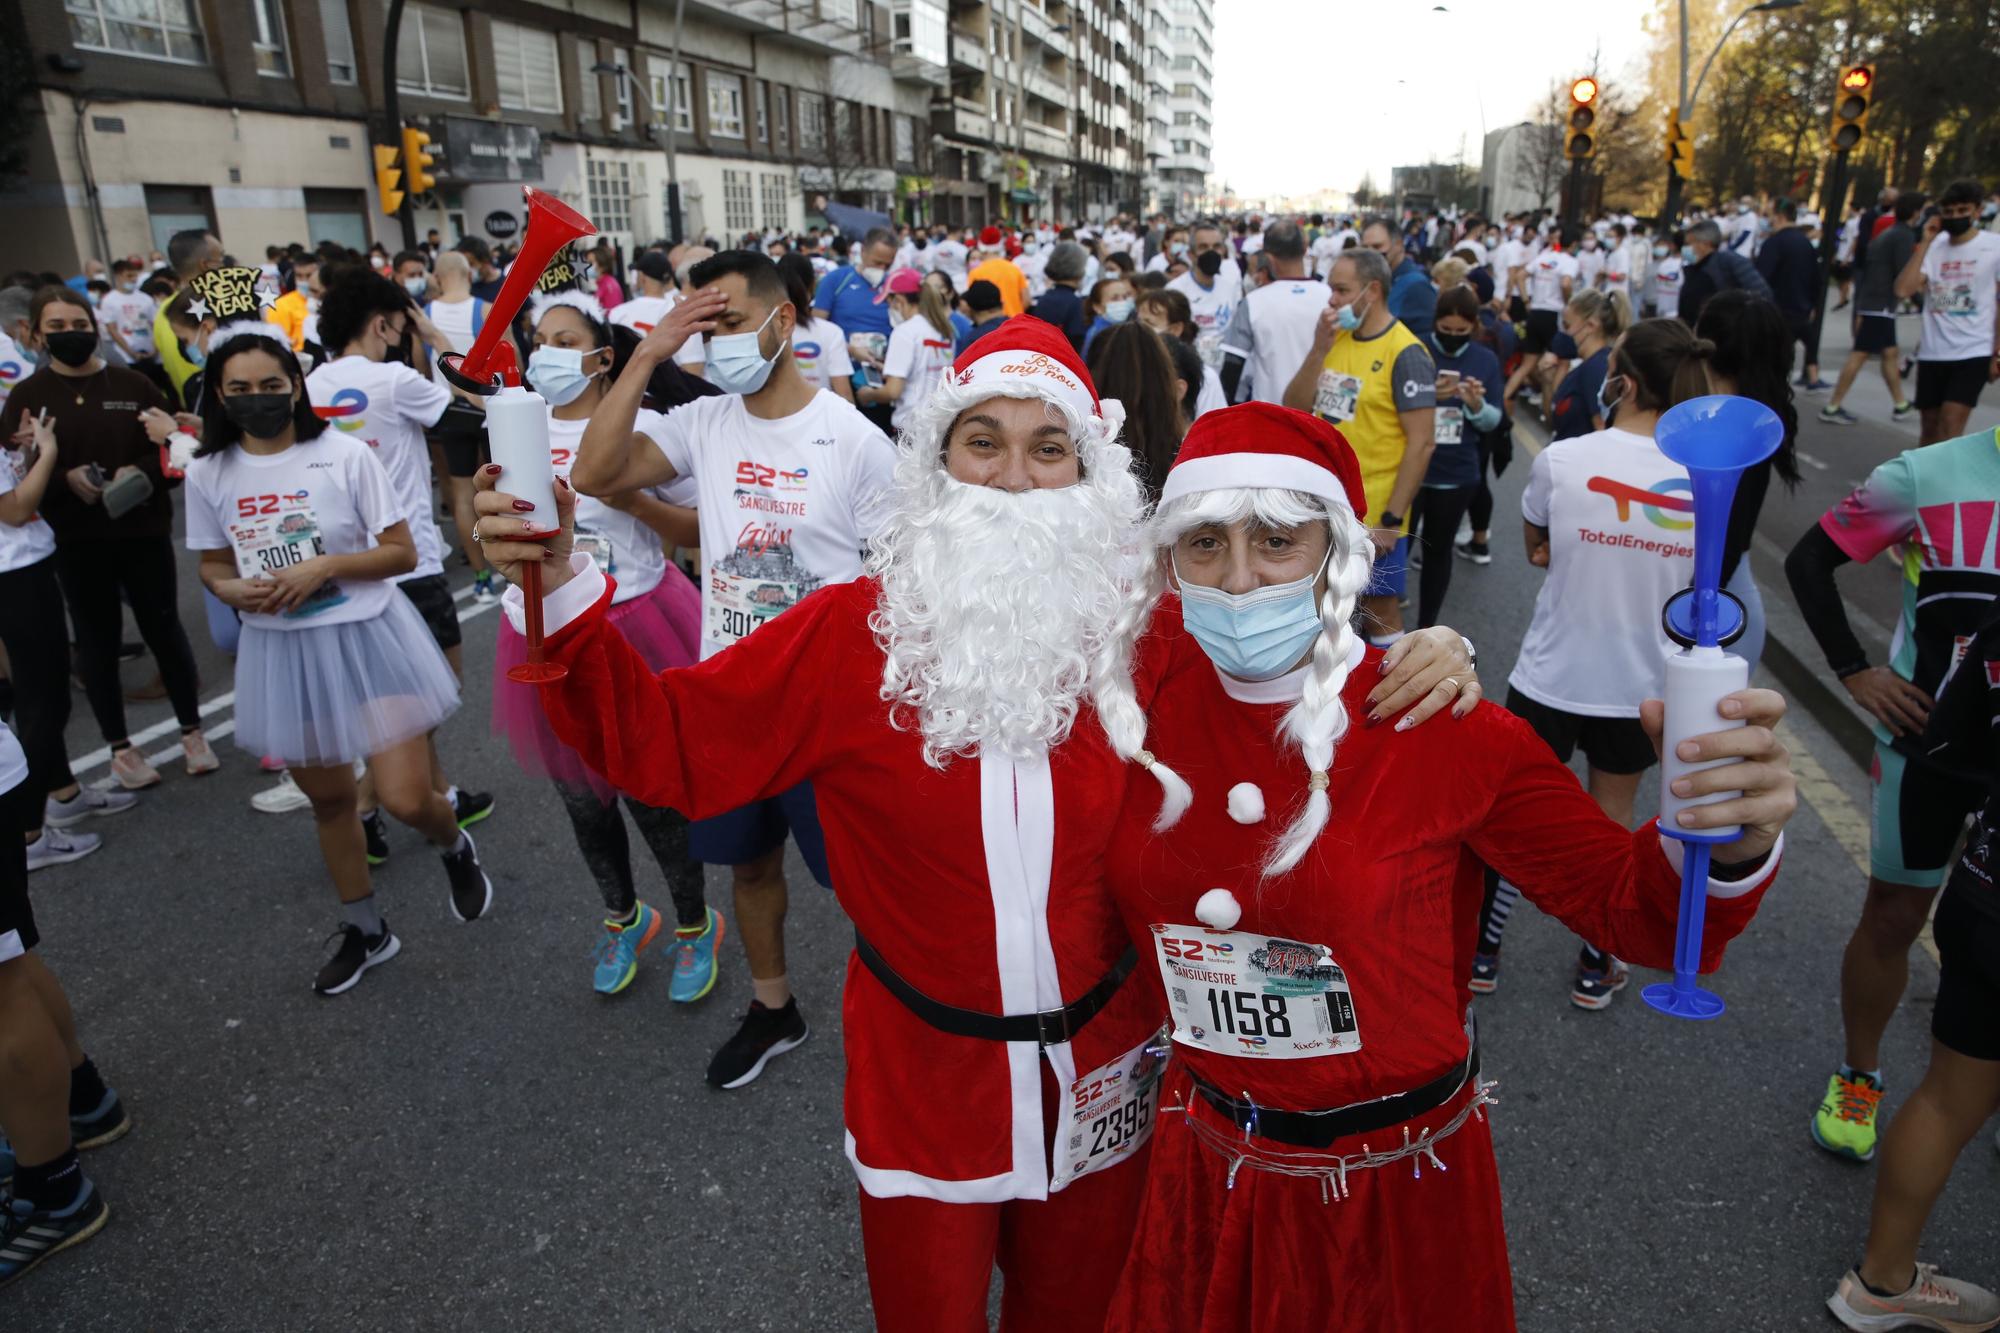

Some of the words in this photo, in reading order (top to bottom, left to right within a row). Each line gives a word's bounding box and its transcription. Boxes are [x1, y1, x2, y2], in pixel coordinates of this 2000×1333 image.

[191, 267, 259, 294] HAPPY
[539, 264, 573, 291] YEAR
[204, 280, 252, 305] NEW
[209, 294, 256, 318] YEAR
[1024, 353, 1061, 373] Bon
[1000, 364, 1040, 377] any
[1044, 369, 1077, 391] nou
[736, 460, 776, 488] 52
[237, 493, 281, 518] 52
[739, 494, 806, 517] SANSILVESTRE
[257, 541, 303, 572] 3016
[1578, 527, 1694, 559] TotalEnergies
[1161, 937, 1204, 962] 52
[1173, 964, 1238, 986] SANSILVESTRE
[1207, 987, 1292, 1038] 1158
[1074, 1079, 1104, 1110] 52
[1077, 1095, 1121, 1125] SANSILVESTRE
[1088, 1089, 1151, 1158] 2395
